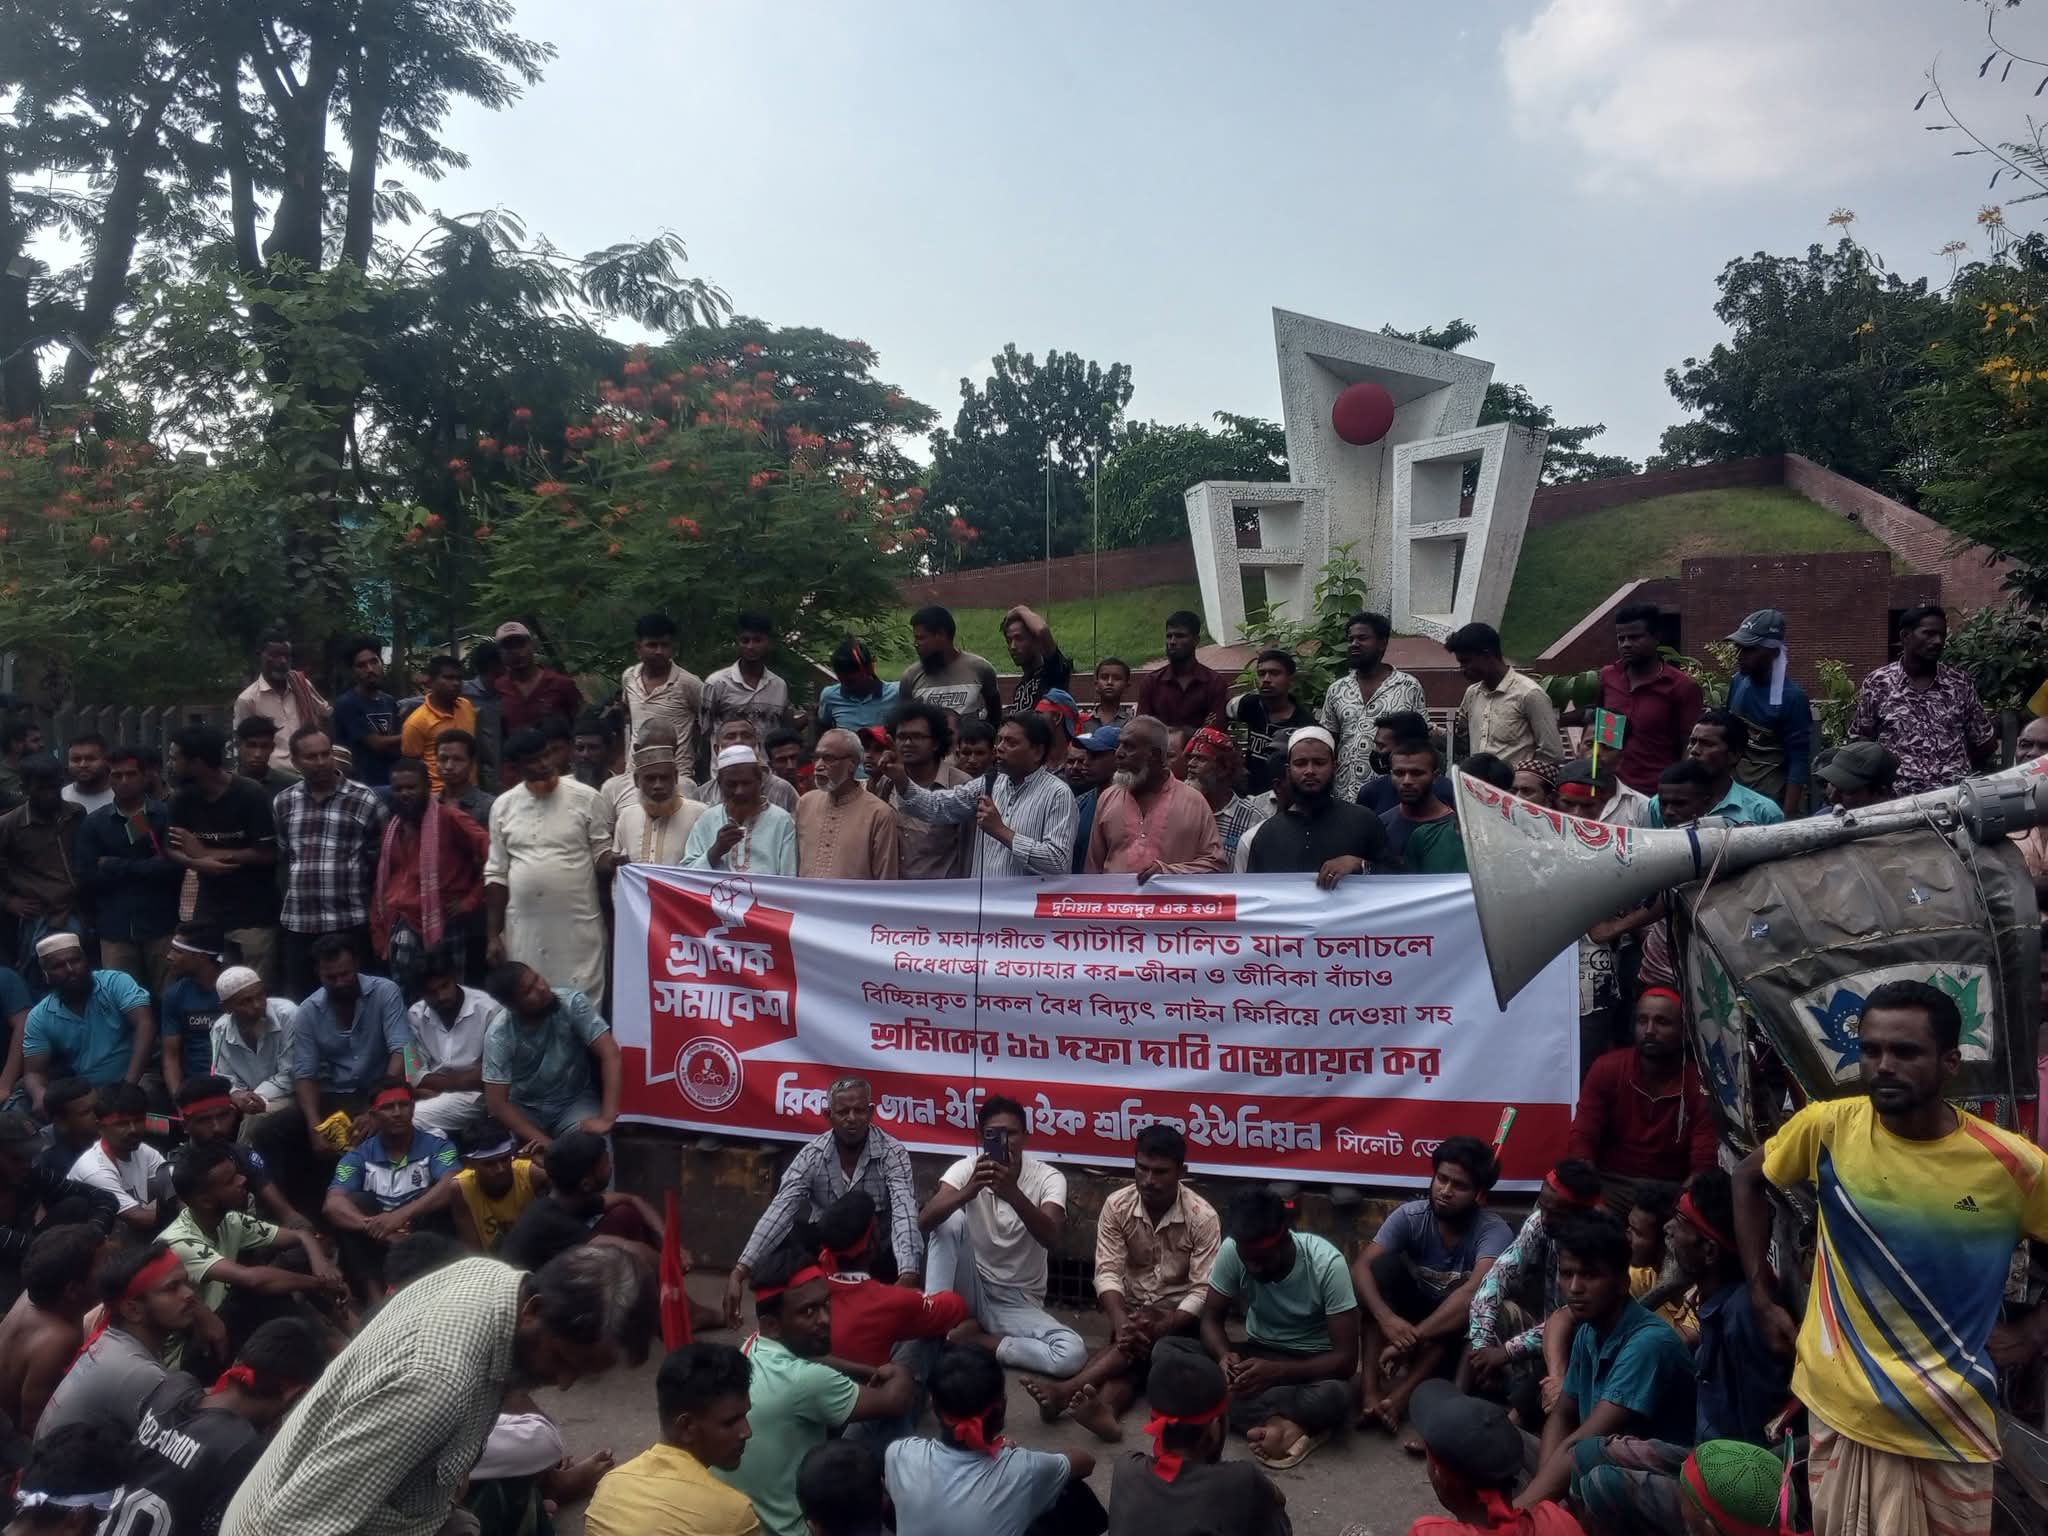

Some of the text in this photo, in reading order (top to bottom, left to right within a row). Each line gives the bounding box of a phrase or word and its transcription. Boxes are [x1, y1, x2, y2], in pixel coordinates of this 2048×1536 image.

[1052, 897, 1102, 917] দুনিয়ার
[1107, 902, 1154, 918] মজদুর
[1160, 903, 1187, 914] এক
[666, 926, 774, 978] শ্রমিক
[871, 923, 1434, 959] সিলেট মহানগরীতে ব্যাটারি চালিত যান চলাচলে
[995, 960, 1076, 980] প্রত্যাহার
[1205, 968, 1225, 984] ও
[1232, 963, 1318, 987] জীবিকা
[1324, 963, 1393, 987] বাঁচাও
[653, 981, 789, 1027] সমাবেশ
[862, 981, 1454, 1026] বিচ্ছিন্নকৃত সকল বৈধ বিদ্যুৎ লাইন ফিরিয়ে দেওয়া সহ
[870, 1017, 1442, 1084] শ্রমিকের ১১ দফা দাবি বাস্তবায়ন কর
[1188, 1103, 1322, 1153] ইউনিয়ন
[1336, 1127, 1404, 1157] সিলেট
[150, 1429, 201, 1469] AMIN
